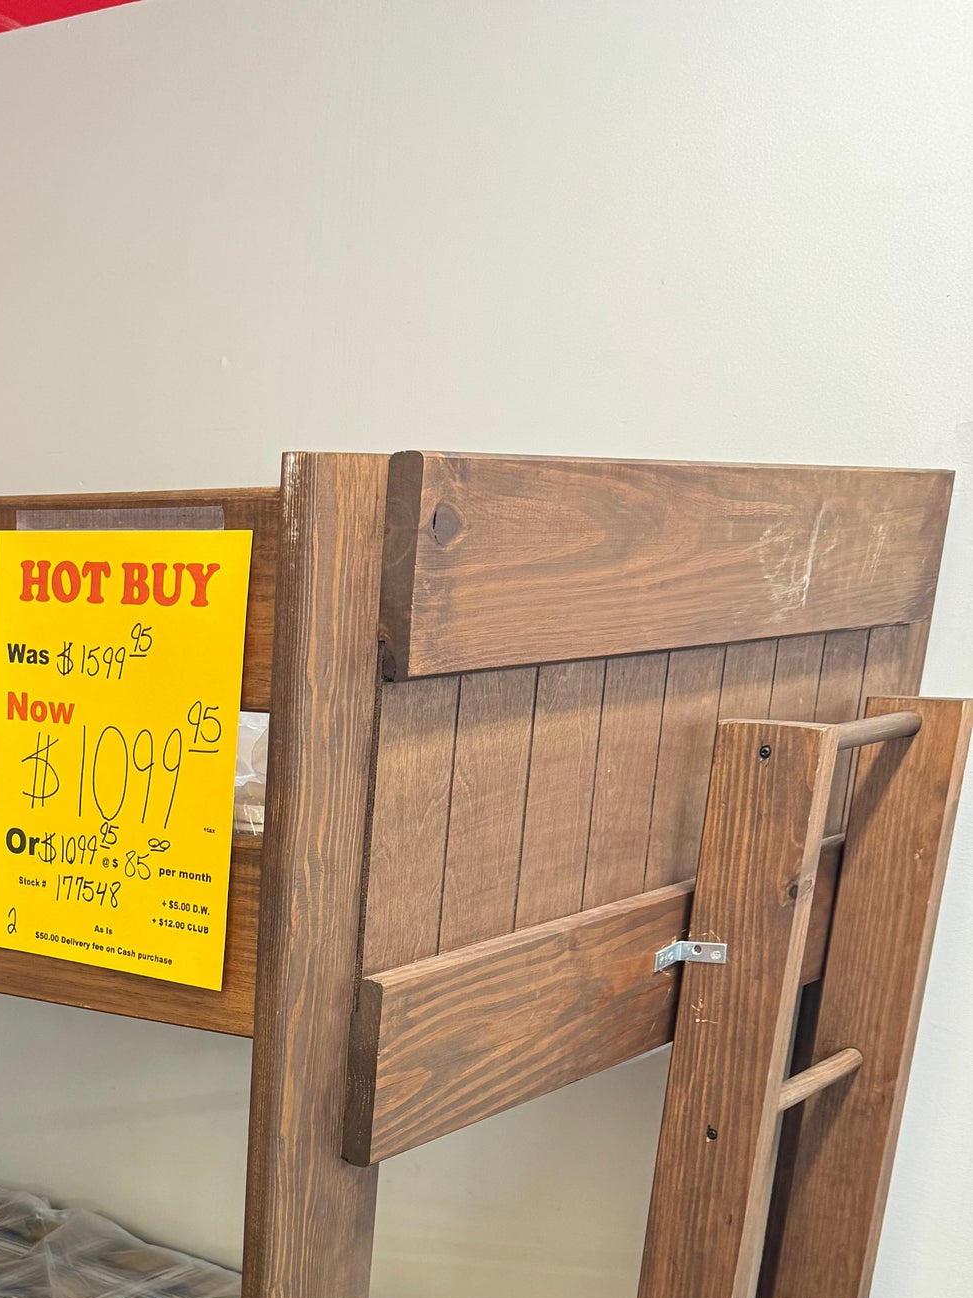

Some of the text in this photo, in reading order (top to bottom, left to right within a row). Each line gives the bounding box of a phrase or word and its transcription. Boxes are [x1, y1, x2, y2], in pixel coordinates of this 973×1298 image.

[19, 560, 221, 607] HOT BUY
[7, 643, 49, 665] Was
[6, 691, 75, 725] Now
[5, 827, 40, 856] Or
[158, 866, 176, 878] per
[178, 869, 212, 883] month
[18, 876, 40, 887] Stock
[56, 874, 122, 909] 177548
[168, 900, 191, 913] $5.00
[192, 904, 211, 916] D.W.
[94, 925, 104, 934] As
[158, 918, 185, 930] $12.00
[187, 923, 209, 935] CLUB
[35, 931, 173, 966] $50.00 Delivery fee on Cash purchase
